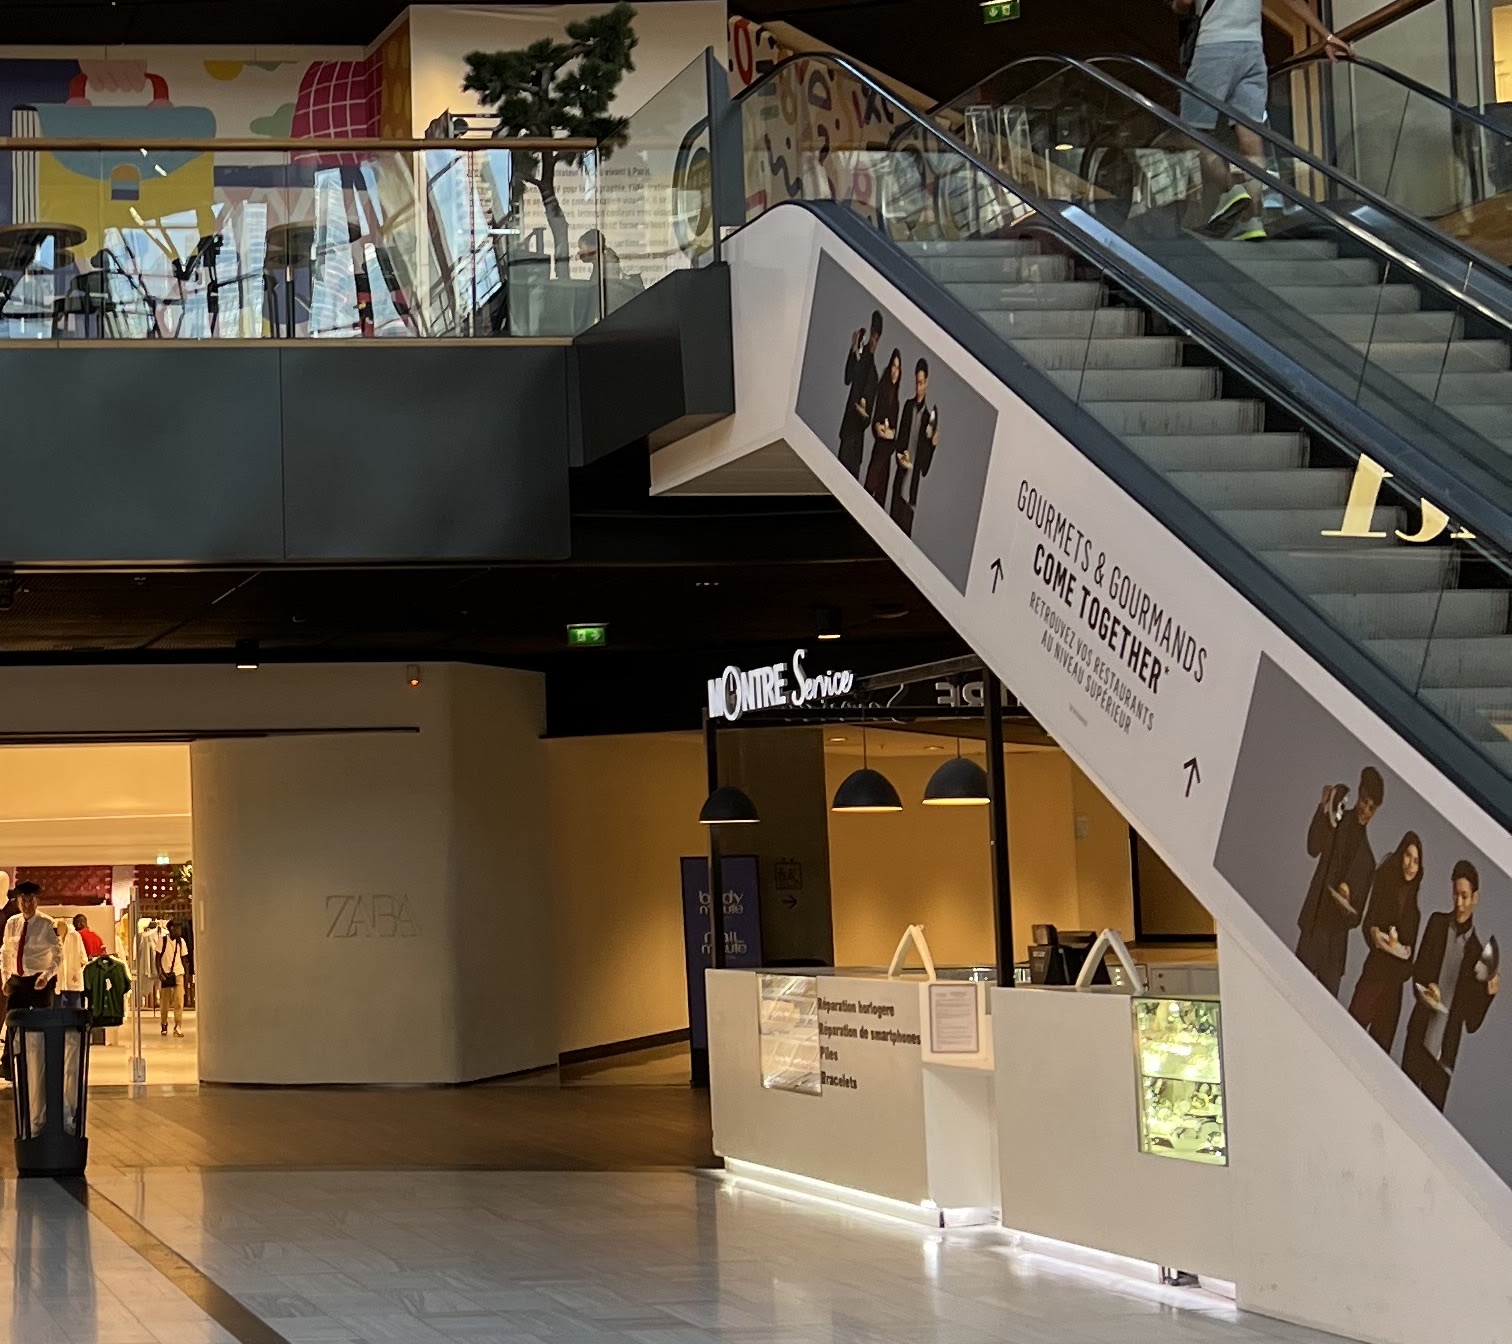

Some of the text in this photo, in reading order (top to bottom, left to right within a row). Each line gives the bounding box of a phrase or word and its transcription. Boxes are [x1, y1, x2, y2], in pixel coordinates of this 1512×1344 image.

[1017, 479, 1208, 683] GOURMETS & GOURMANDS
[1033, 543, 1077, 607] COME
[707, 663, 788, 721] MONTRE
[791, 648, 854, 706] Service
[1029, 591, 1076, 648] RETROUVEZ
[1076, 634, 1094, 668] VOS
[1093, 656, 1155, 732] RESTAURANTS
[1041, 629, 1054, 654] AU
[1053, 645, 1086, 685] NIVEAU
[1085, 674, 1133, 736] SUPÉRIEUR
[325, 893, 424, 939] ZARA
[820, 1045, 838, 1061] Piles
[859, 1024, 869, 1040] de
[870, 1028, 921, 1046] smartphones
[821, 1070, 858, 1089] Bracelets
